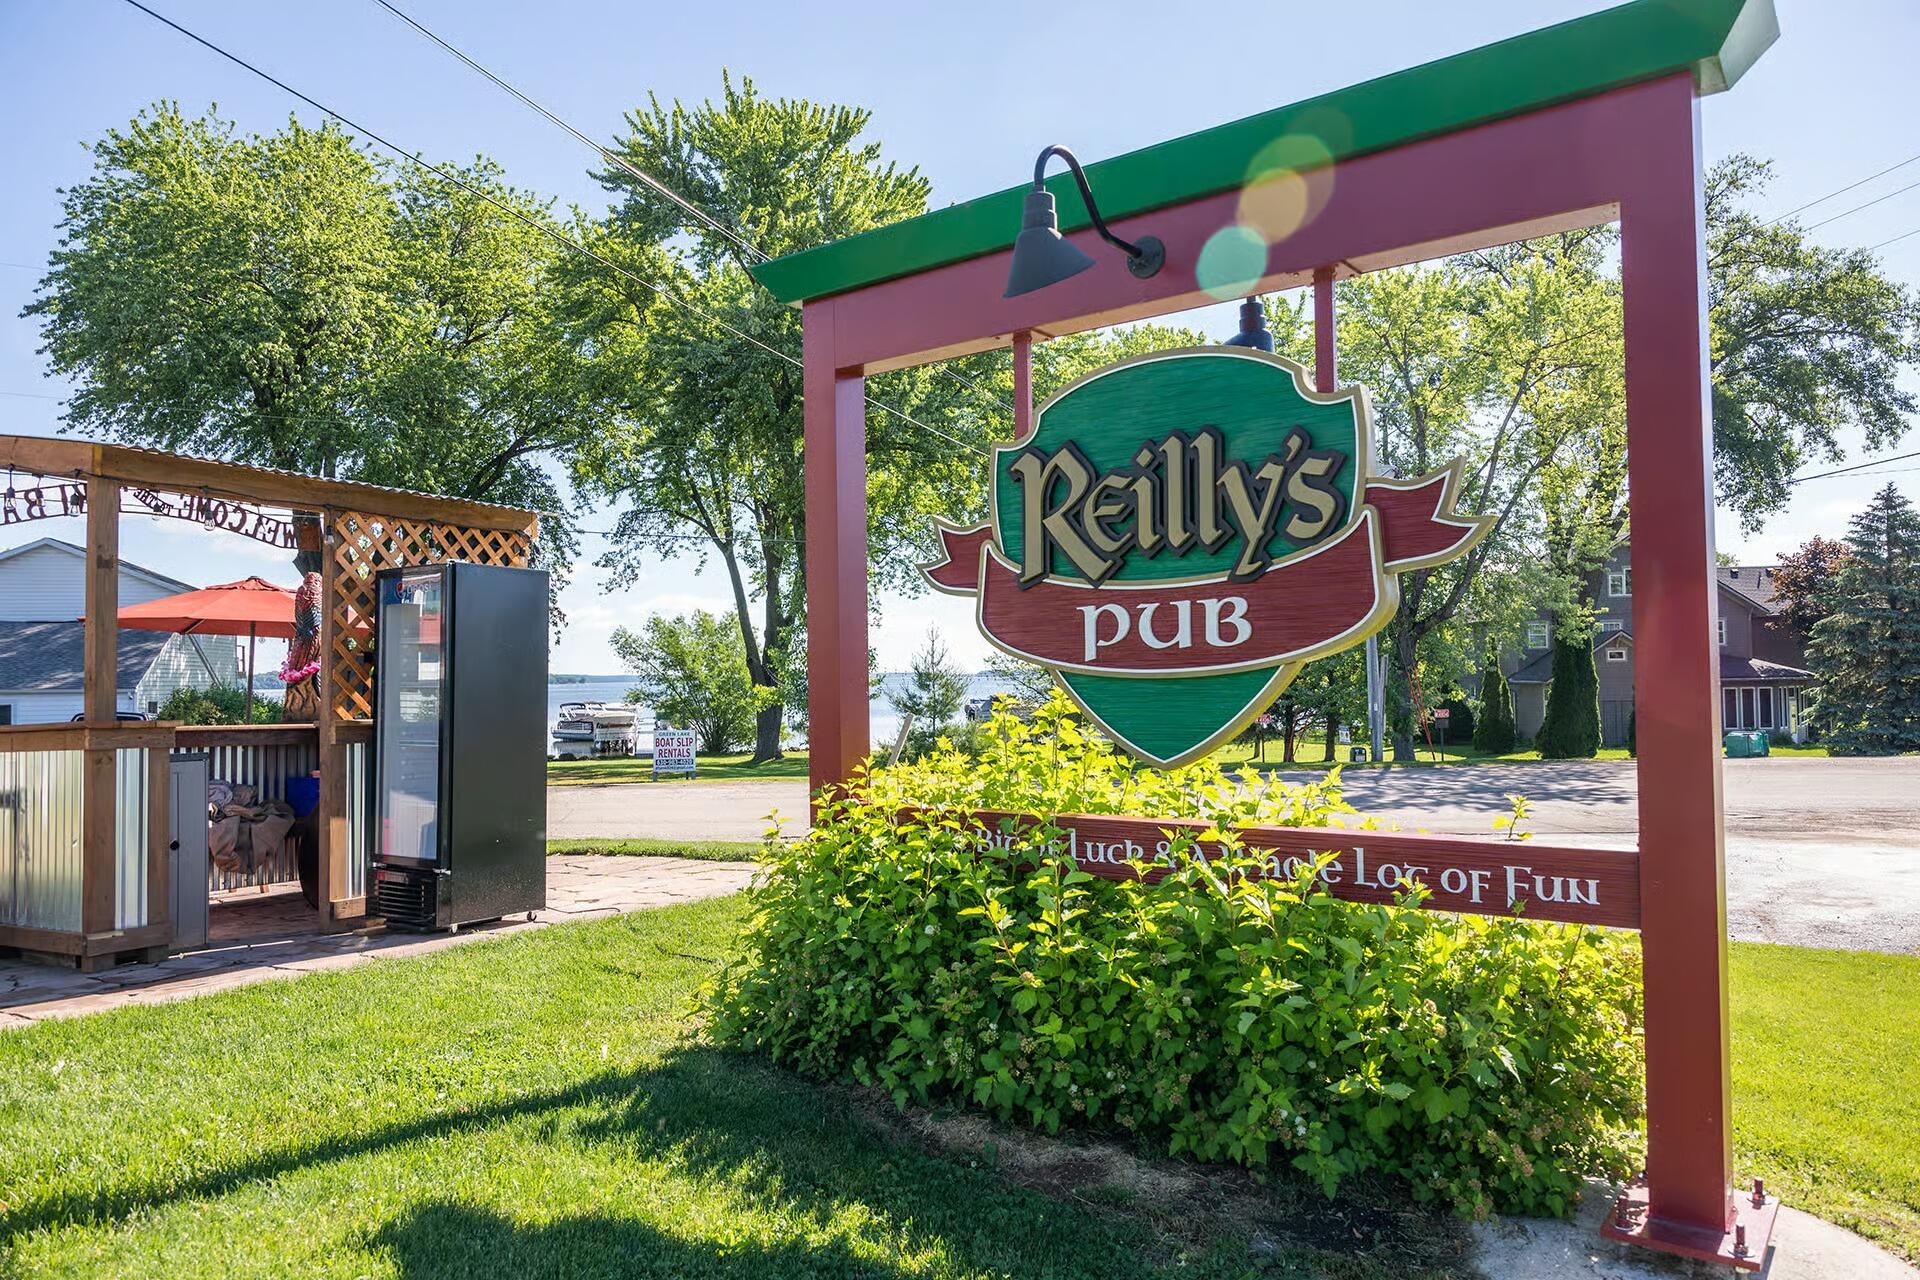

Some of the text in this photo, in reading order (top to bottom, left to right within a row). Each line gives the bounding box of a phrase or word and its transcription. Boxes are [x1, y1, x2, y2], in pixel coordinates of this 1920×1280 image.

[1009, 427, 1342, 586] Reilly's
[655, 737, 693, 747] BOAT SLIP
[658, 748, 691, 758] RENTALS
[1353, 847, 1429, 890] Lot
